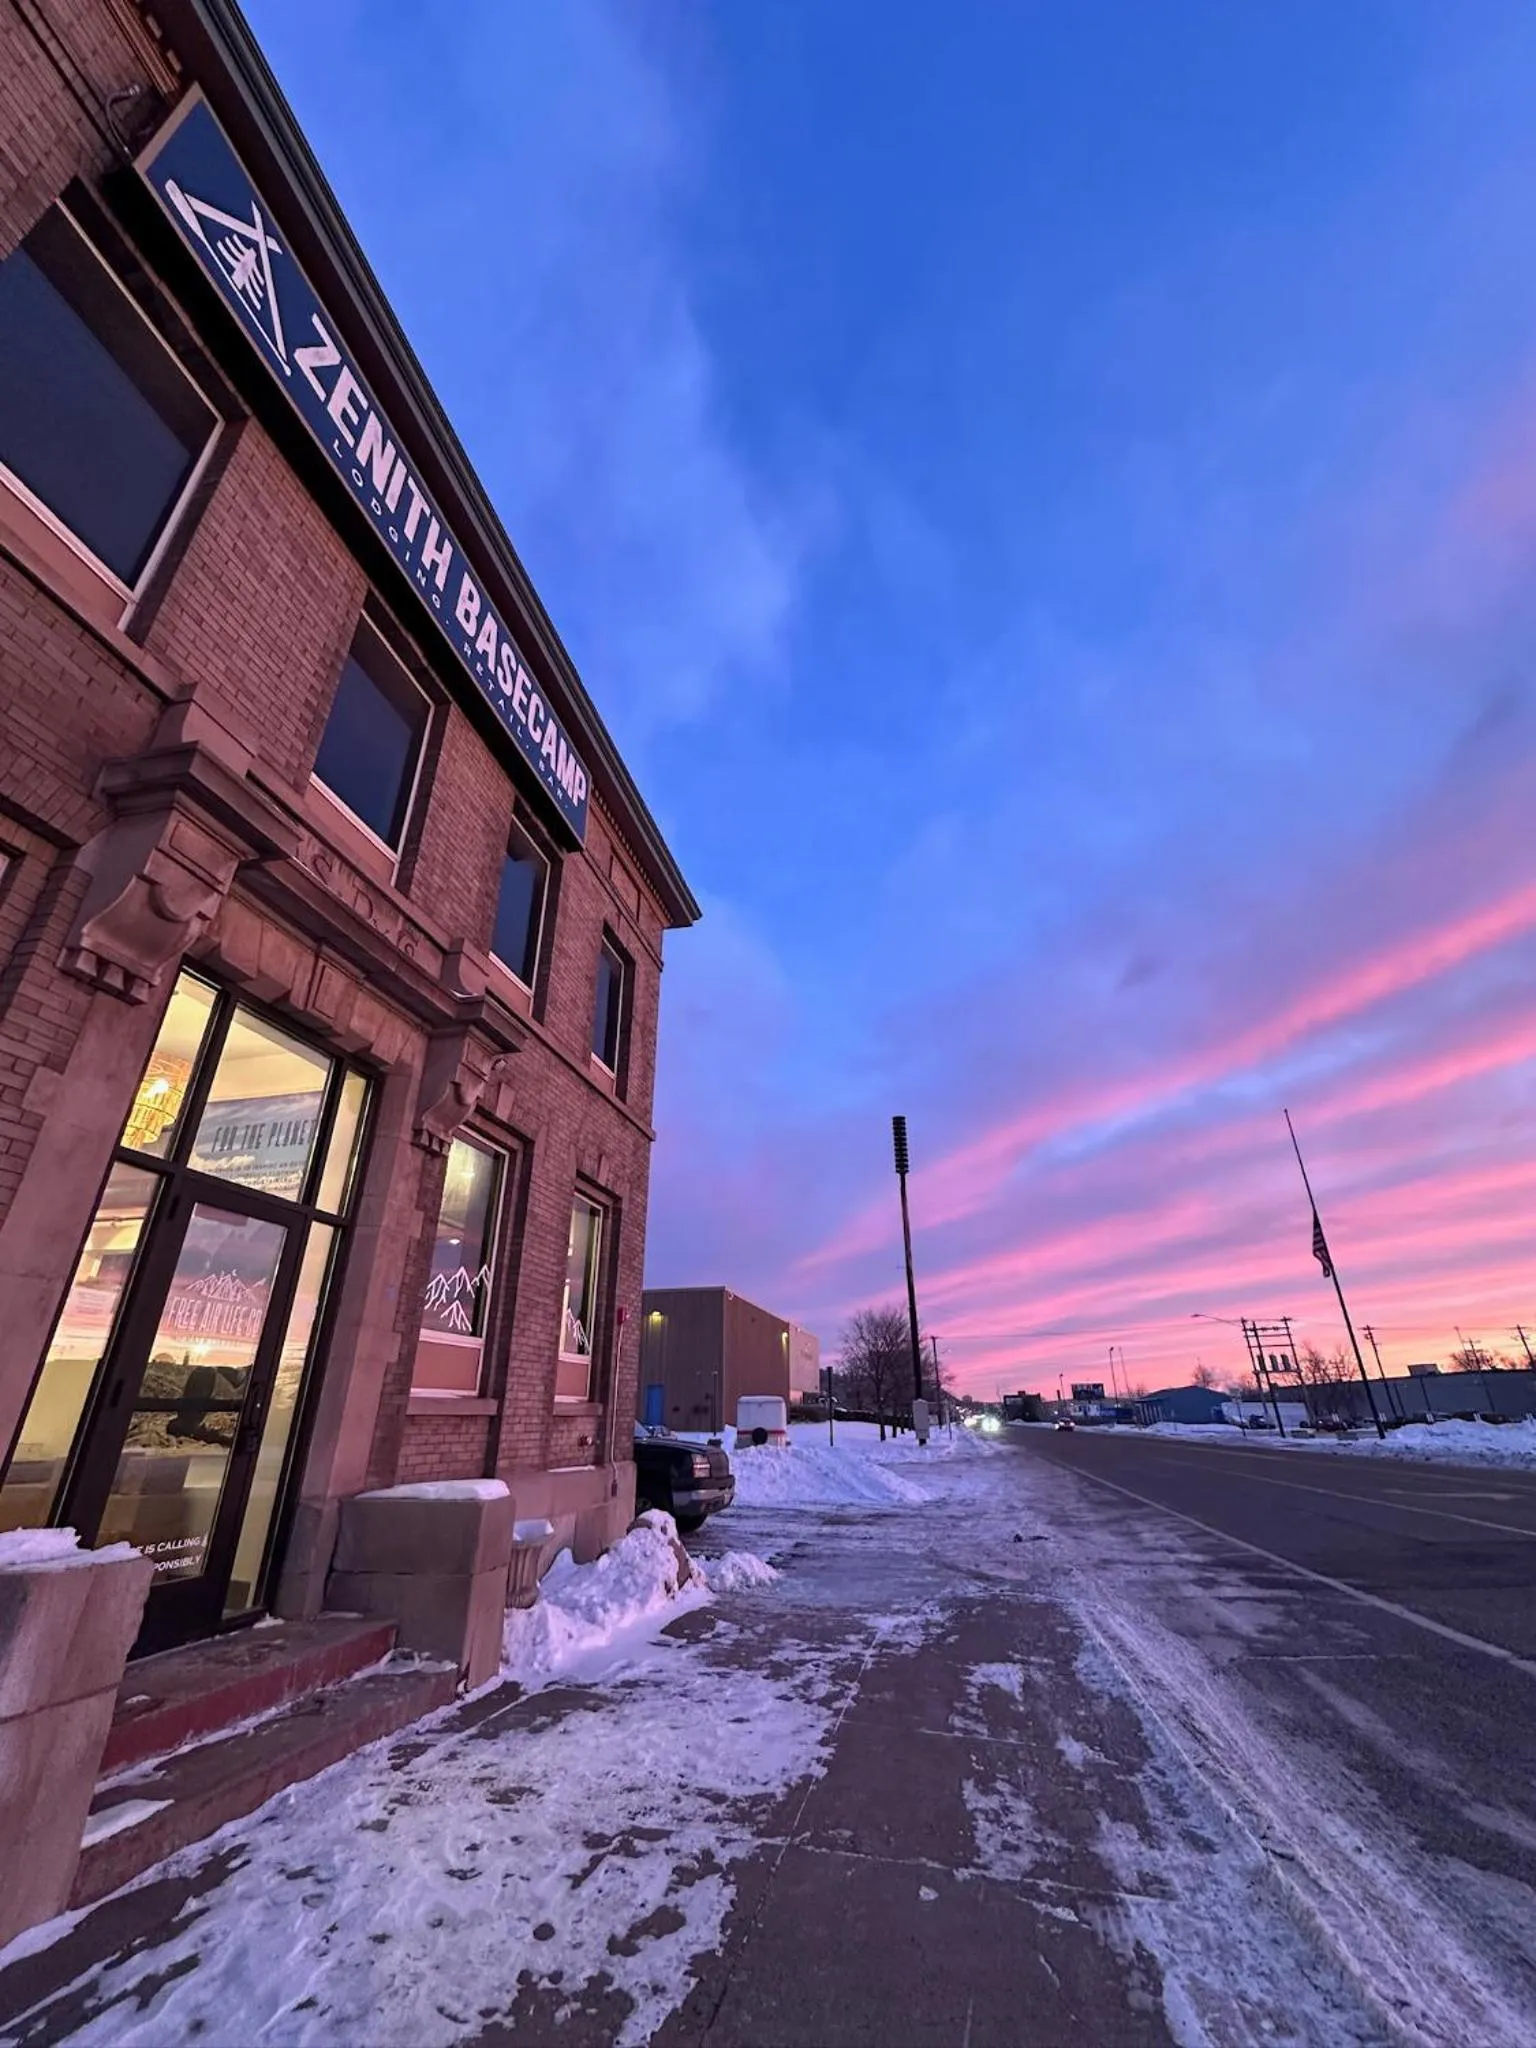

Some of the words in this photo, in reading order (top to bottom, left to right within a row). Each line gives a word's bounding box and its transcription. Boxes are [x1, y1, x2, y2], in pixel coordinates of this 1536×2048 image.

[294, 312, 454, 592] ZENITH
[455, 571, 587, 807] BASECAMP
[167, 1296, 201, 1330] FREE
[144, 1544, 155, 1554] IS
[152, 1555, 202, 1571] PONSIBLY
